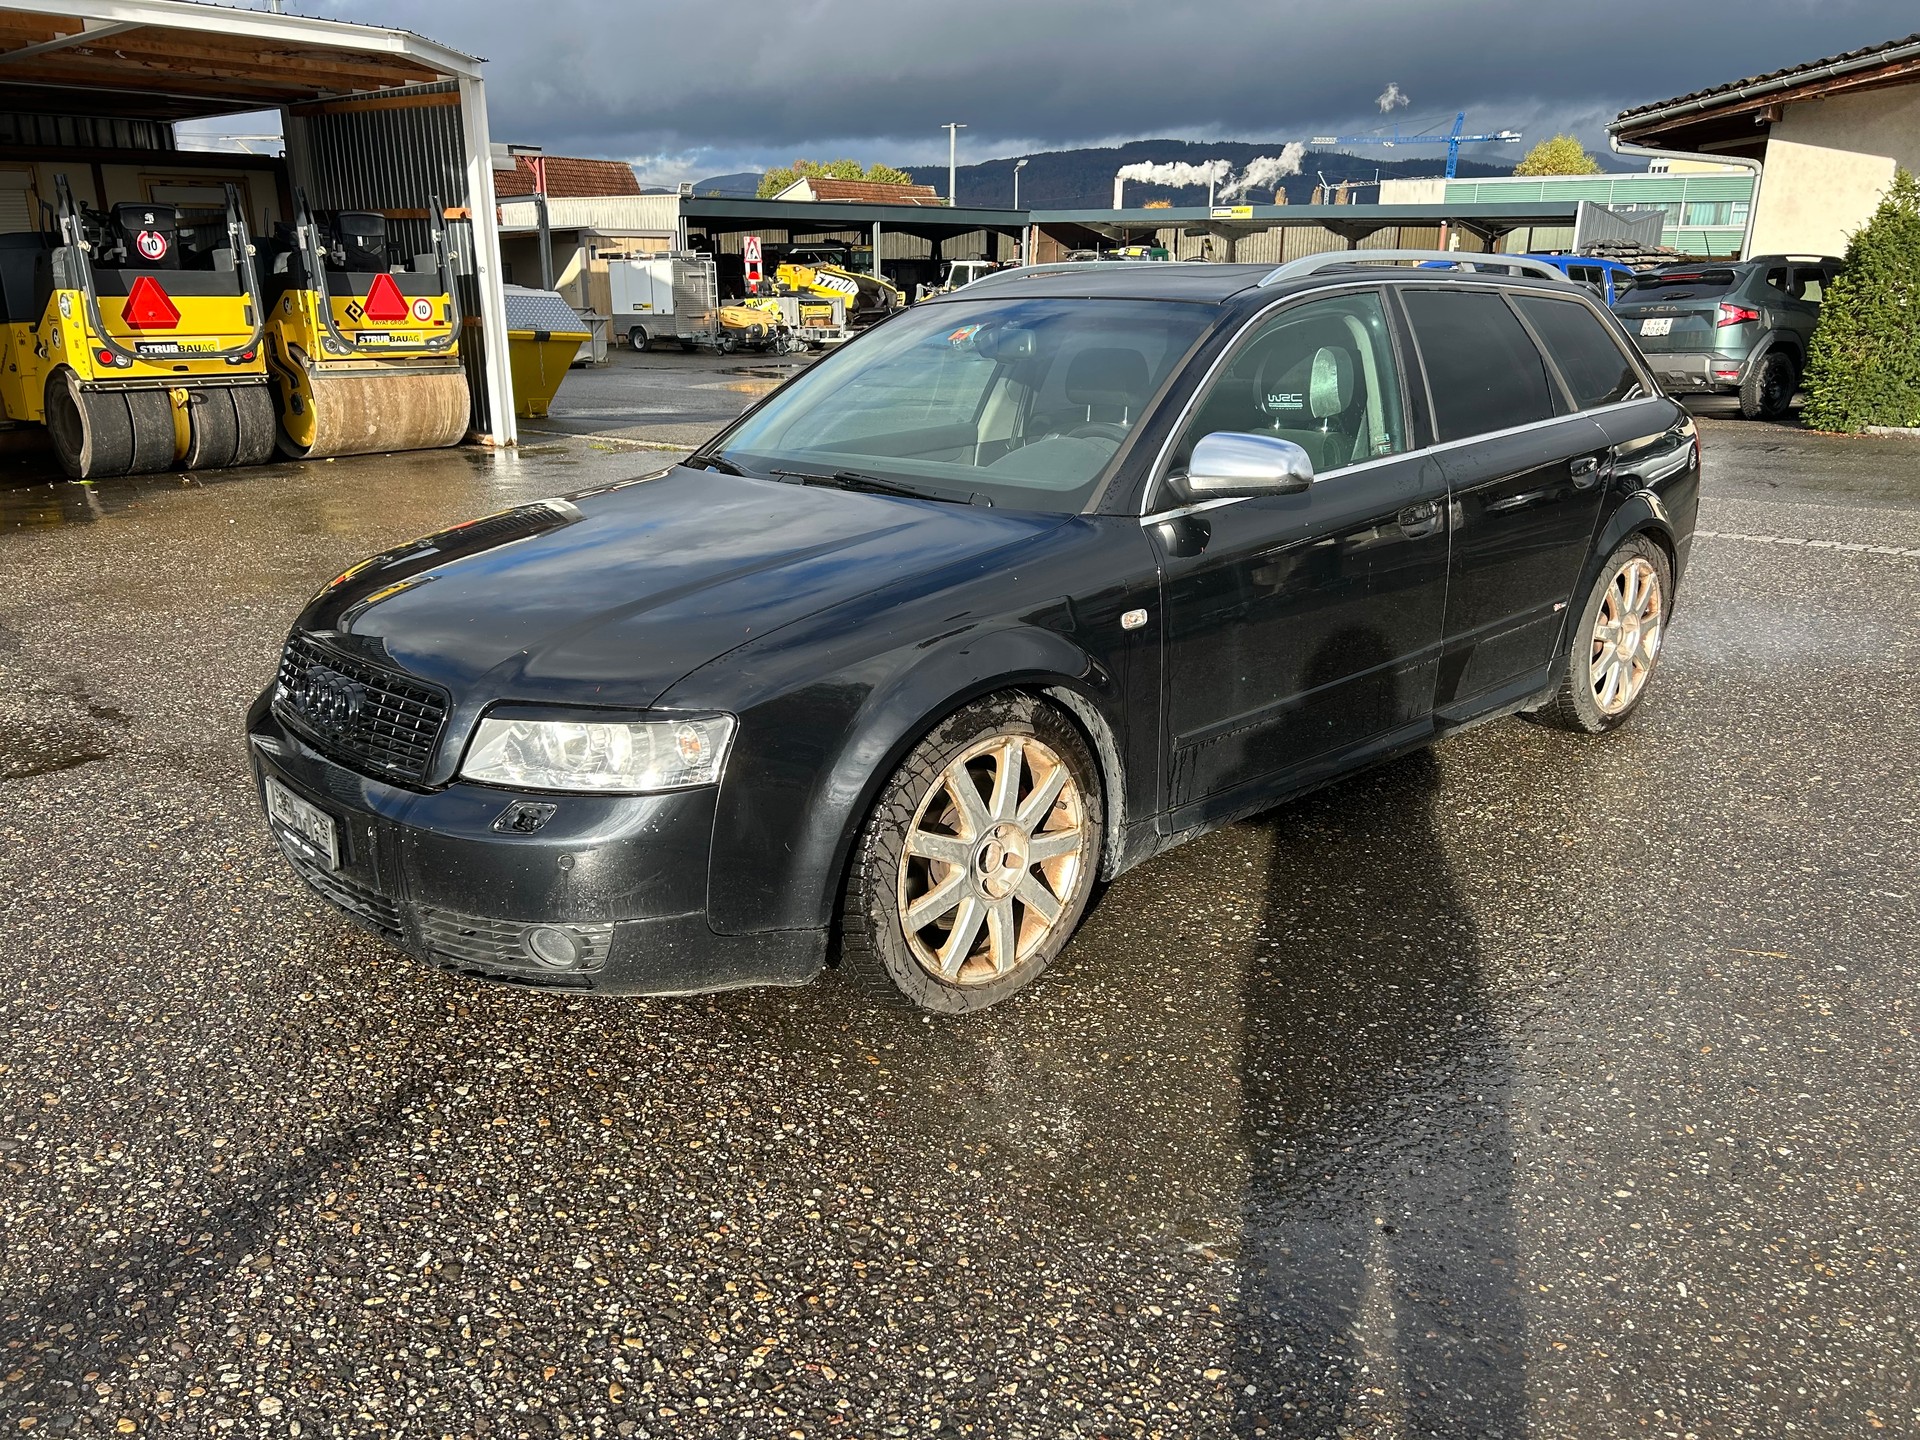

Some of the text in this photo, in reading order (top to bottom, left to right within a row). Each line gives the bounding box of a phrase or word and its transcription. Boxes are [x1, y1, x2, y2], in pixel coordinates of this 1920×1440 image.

[147, 240, 158, 251] 10
[418, 304, 427, 315] 10
[1640, 305, 1678, 313] DACIA
[1267, 393, 1303, 402] WRC
